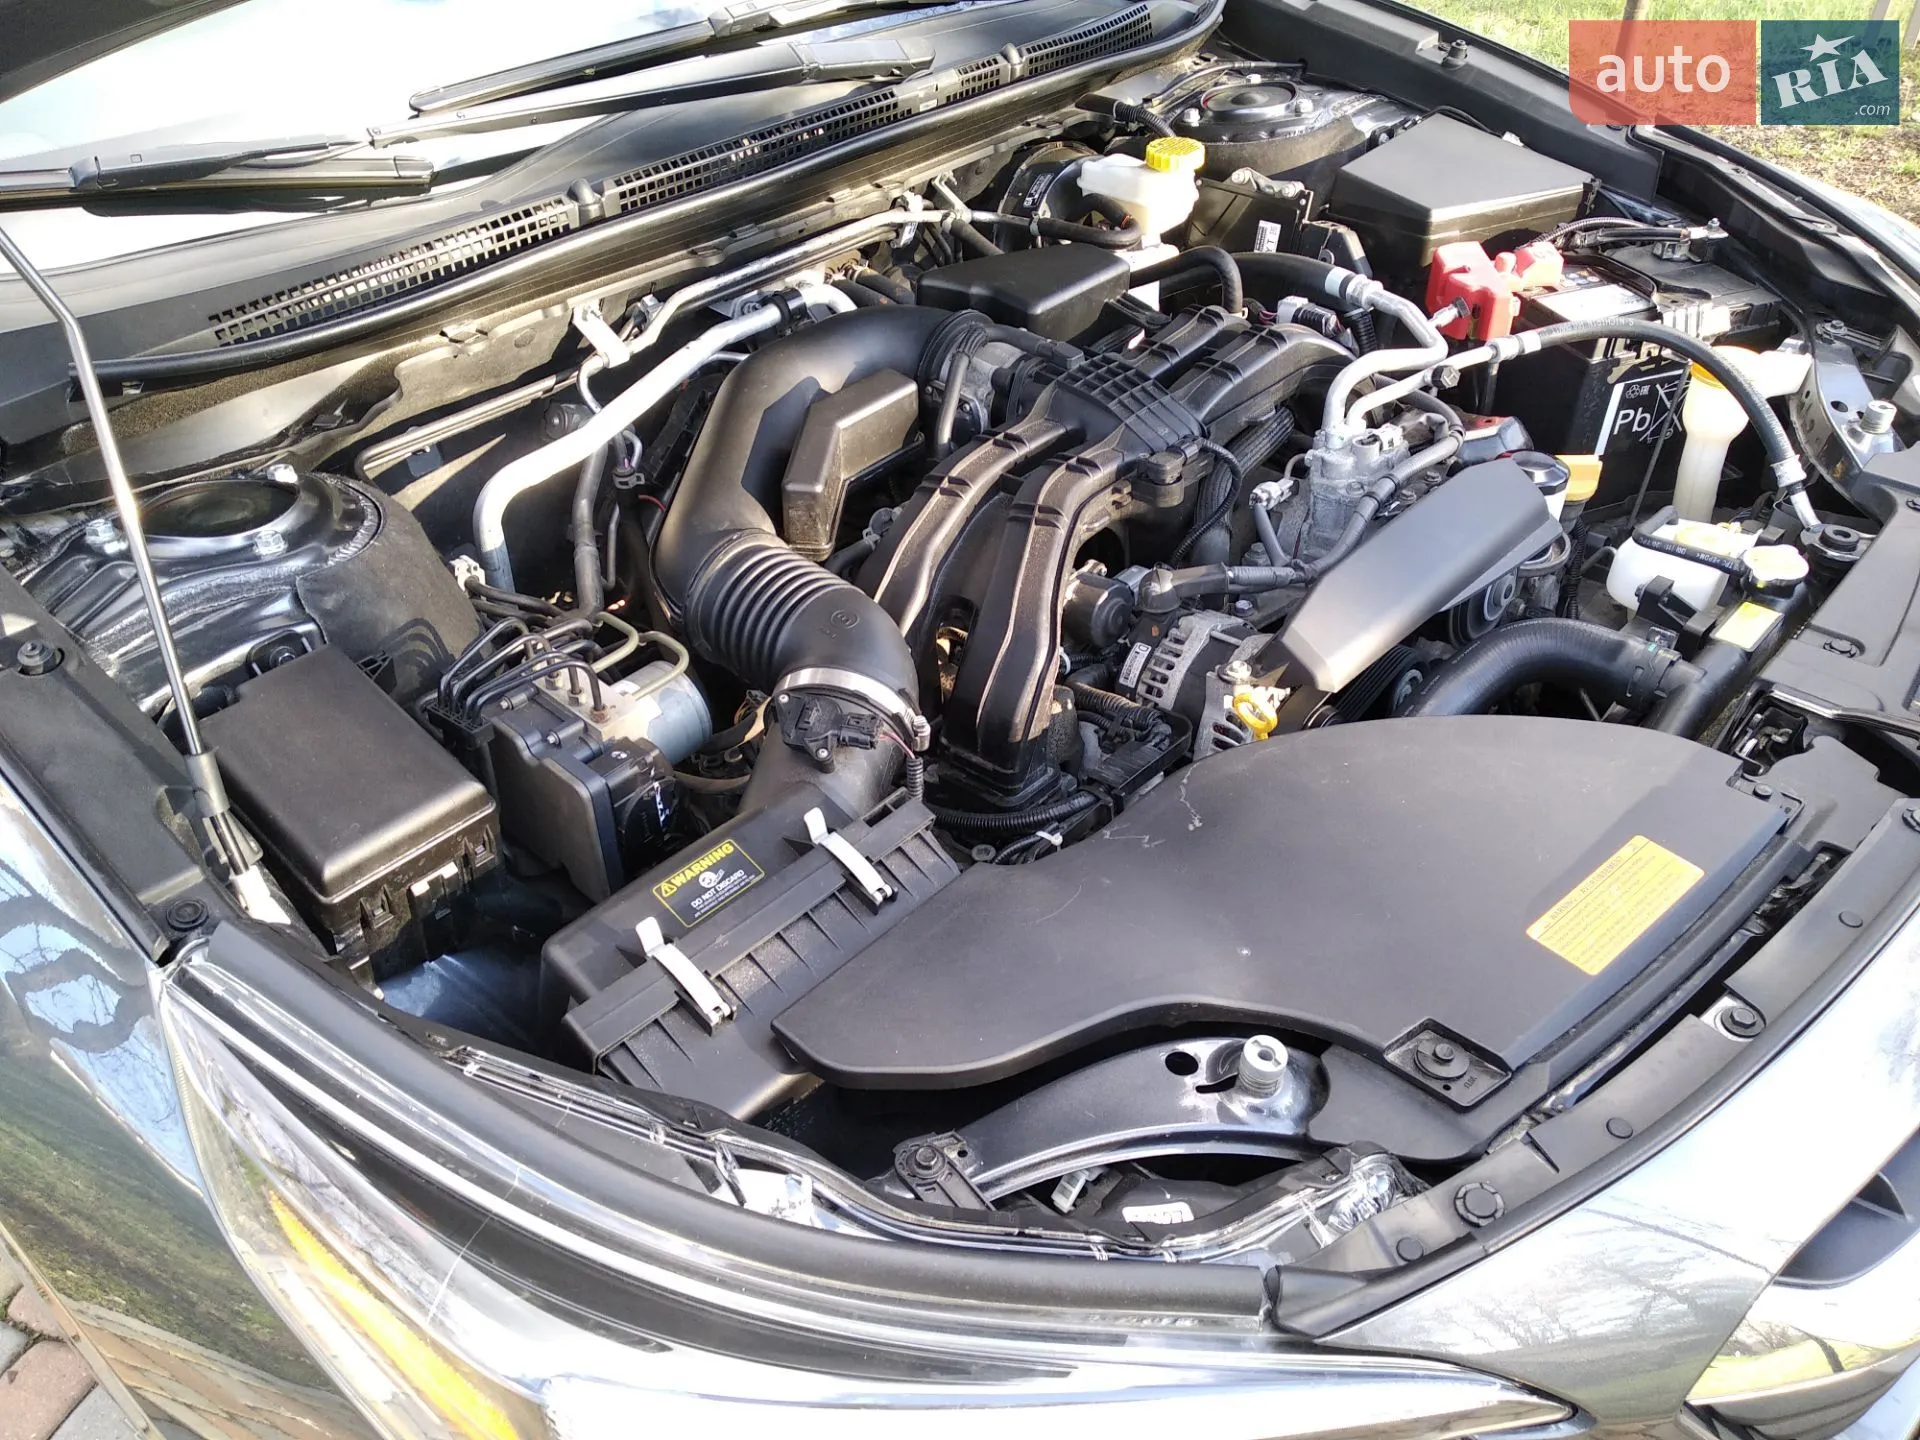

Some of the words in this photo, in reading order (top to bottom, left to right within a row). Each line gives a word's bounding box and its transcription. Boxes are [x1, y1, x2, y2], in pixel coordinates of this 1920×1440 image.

[1613, 407, 1651, 435] Pb
[671, 843, 734, 887] WARNING
[691, 898, 703, 908] DO
[701, 888, 718, 901] NOT
[715, 868, 745, 892] DISCARD
